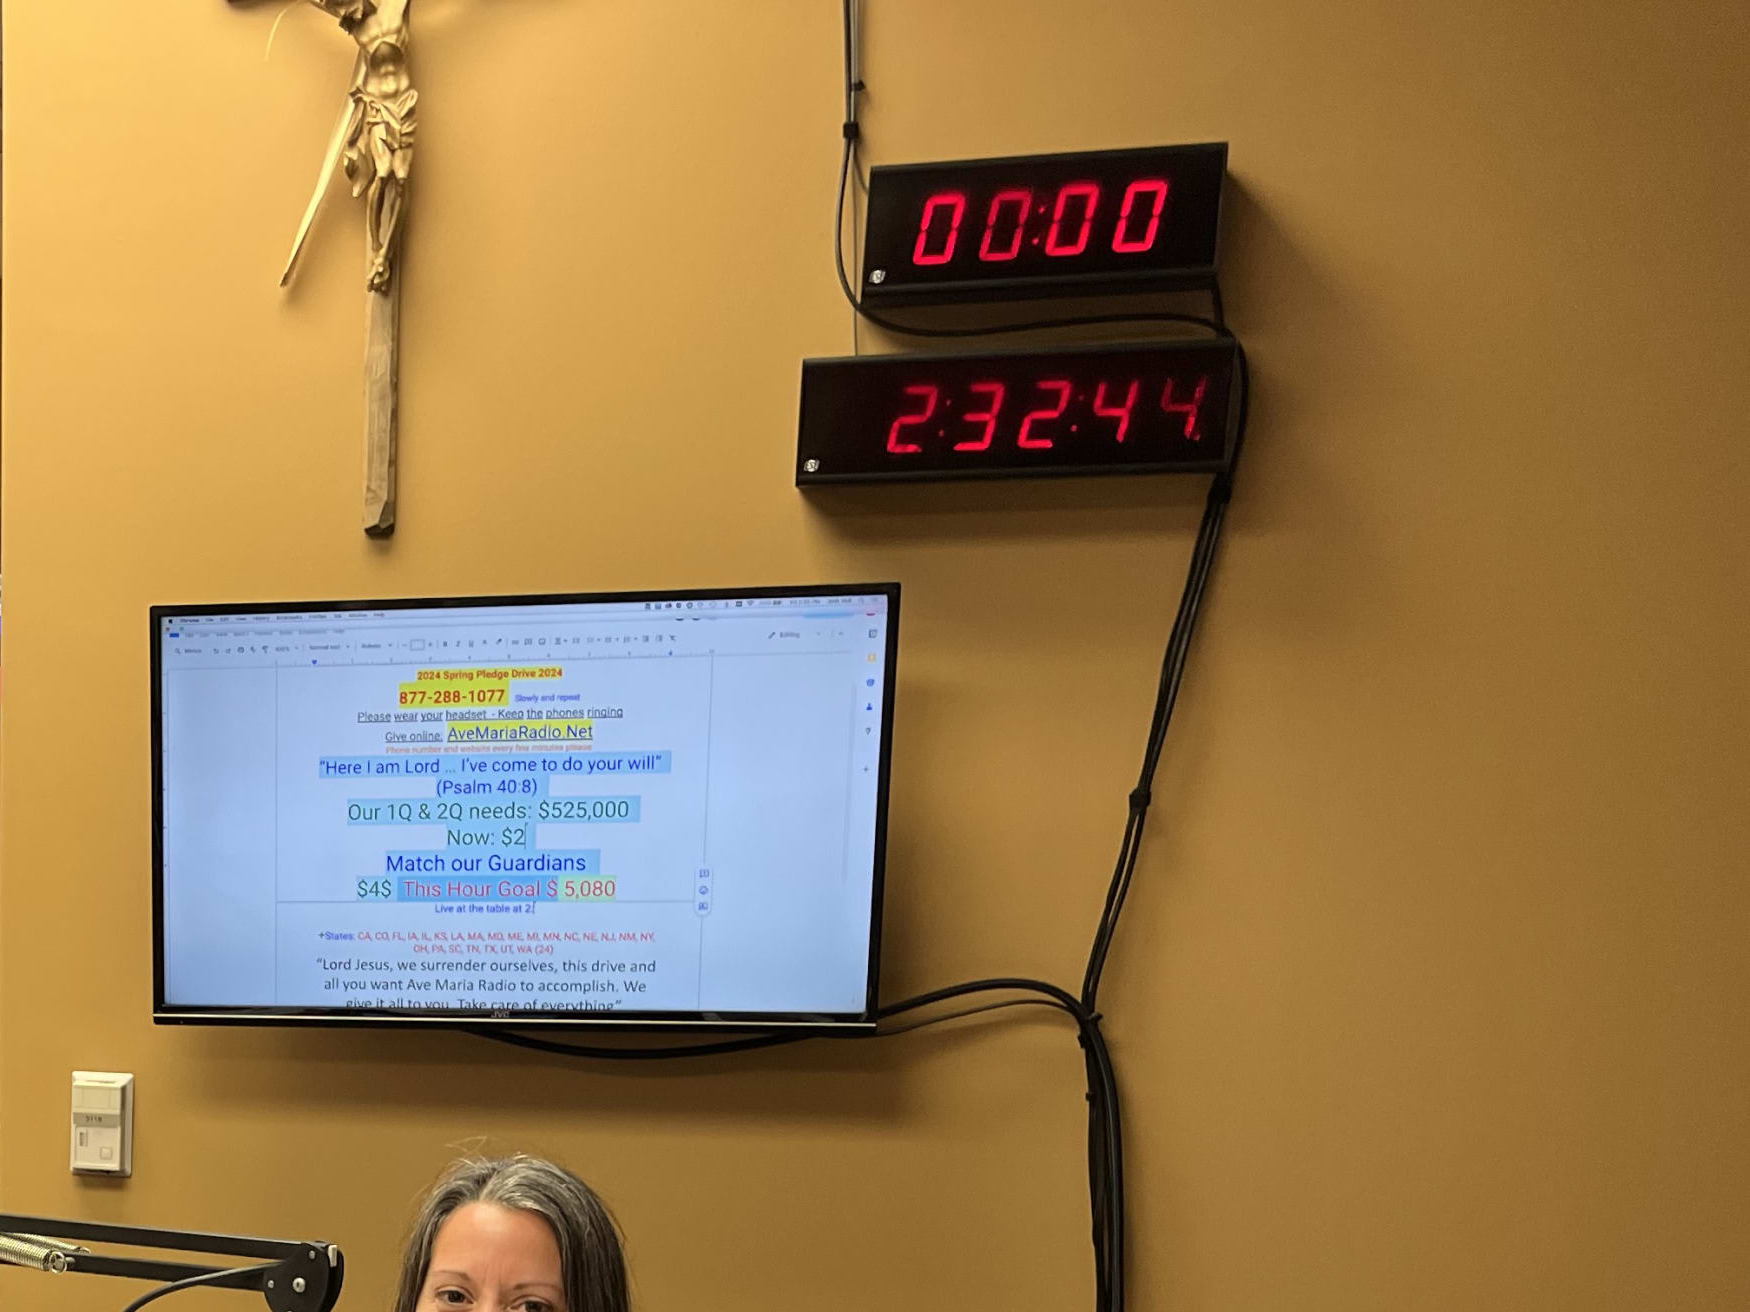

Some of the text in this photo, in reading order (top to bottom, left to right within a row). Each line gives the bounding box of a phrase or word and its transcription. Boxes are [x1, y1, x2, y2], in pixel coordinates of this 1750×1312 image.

[912, 179, 1168, 265] 00:00
[886, 376, 1207, 453] 2:32:44
[417, 668, 563, 681] 2024 Spring Pledge Drive 2024
[399, 689, 505, 705] 877-288-1077
[357, 707, 623, 723] Please wear your headset Keep the phones ringing
[385, 732, 407, 742] Give
[447, 724, 593, 742] AveMariaRadio.Net
[367, 760, 371, 774] I
[376, 762, 400, 774] am
[405, 759, 440, 774] Lord
[461, 758, 488, 772] I’ve
[492, 760, 537, 772] come
[542, 758, 557, 772] to
[562, 757, 583, 771] do
[588, 758, 623, 775] your
[436, 778, 537, 798] (Psalm 40:8)
[348, 800, 629, 822] Our 1Q & 2Q needs: $525,000
[447, 829, 495, 846] Now:
[386, 853, 586, 872] Match our Guardians
[357, 878, 616, 899] $4$ This Hour Goal $ 5,080
[355, 958, 393, 972] Jesus,
[397, 961, 417, 971] we
[421, 959, 487, 972] surrender
[490, 960, 558, 973] ourselves,
[563, 960, 587, 972] this
[591, 960, 625, 972] drive
[630, 960, 656, 972] and
[324, 978, 647, 994] all you want Ave Maria Radio to accomplish. We
